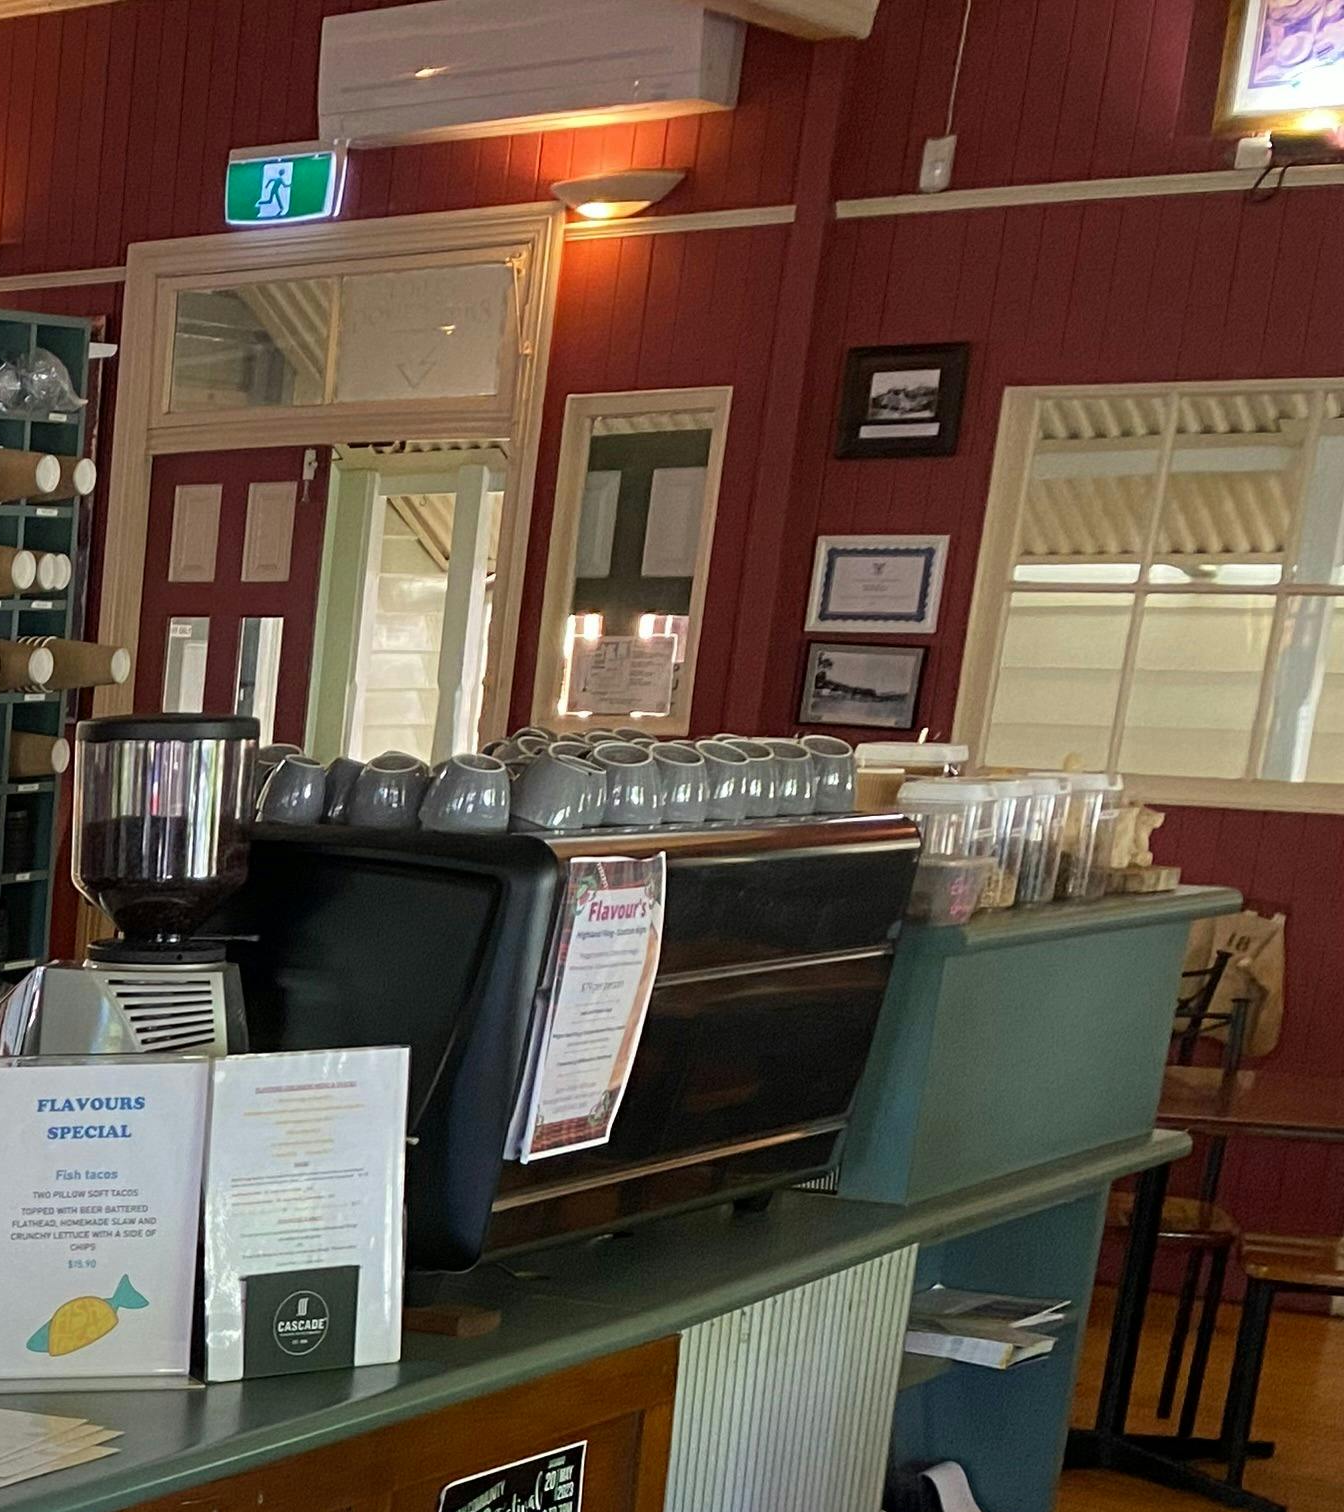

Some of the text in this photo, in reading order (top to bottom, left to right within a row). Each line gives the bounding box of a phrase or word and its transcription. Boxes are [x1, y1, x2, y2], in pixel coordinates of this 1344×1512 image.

[588, 897, 647, 923] Flavour's
[37, 1096, 146, 1113] FLAVOURS
[47, 1124, 132, 1140] SPECIAL
[56, 1169, 118, 1181] Fish tacos
[33, 1188, 139, 1199] TWO PILLOW SOFT TACOS
[21, 1204, 149, 1216] TOPPED WITH BEER BATTERED
[60, 1218, 110, 1227] HOMEMADE
[111, 1217, 137, 1226] SLAW
[138, 1216, 157, 1225] AND
[10, 1229, 157, 1241] CRUNCHY LETTUCE WITH A SIDE OF
[70, 1243, 96, 1252] CHIPS
[277, 1318, 325, 1333] CASCADE
[544, 1470, 557, 1492] 20
